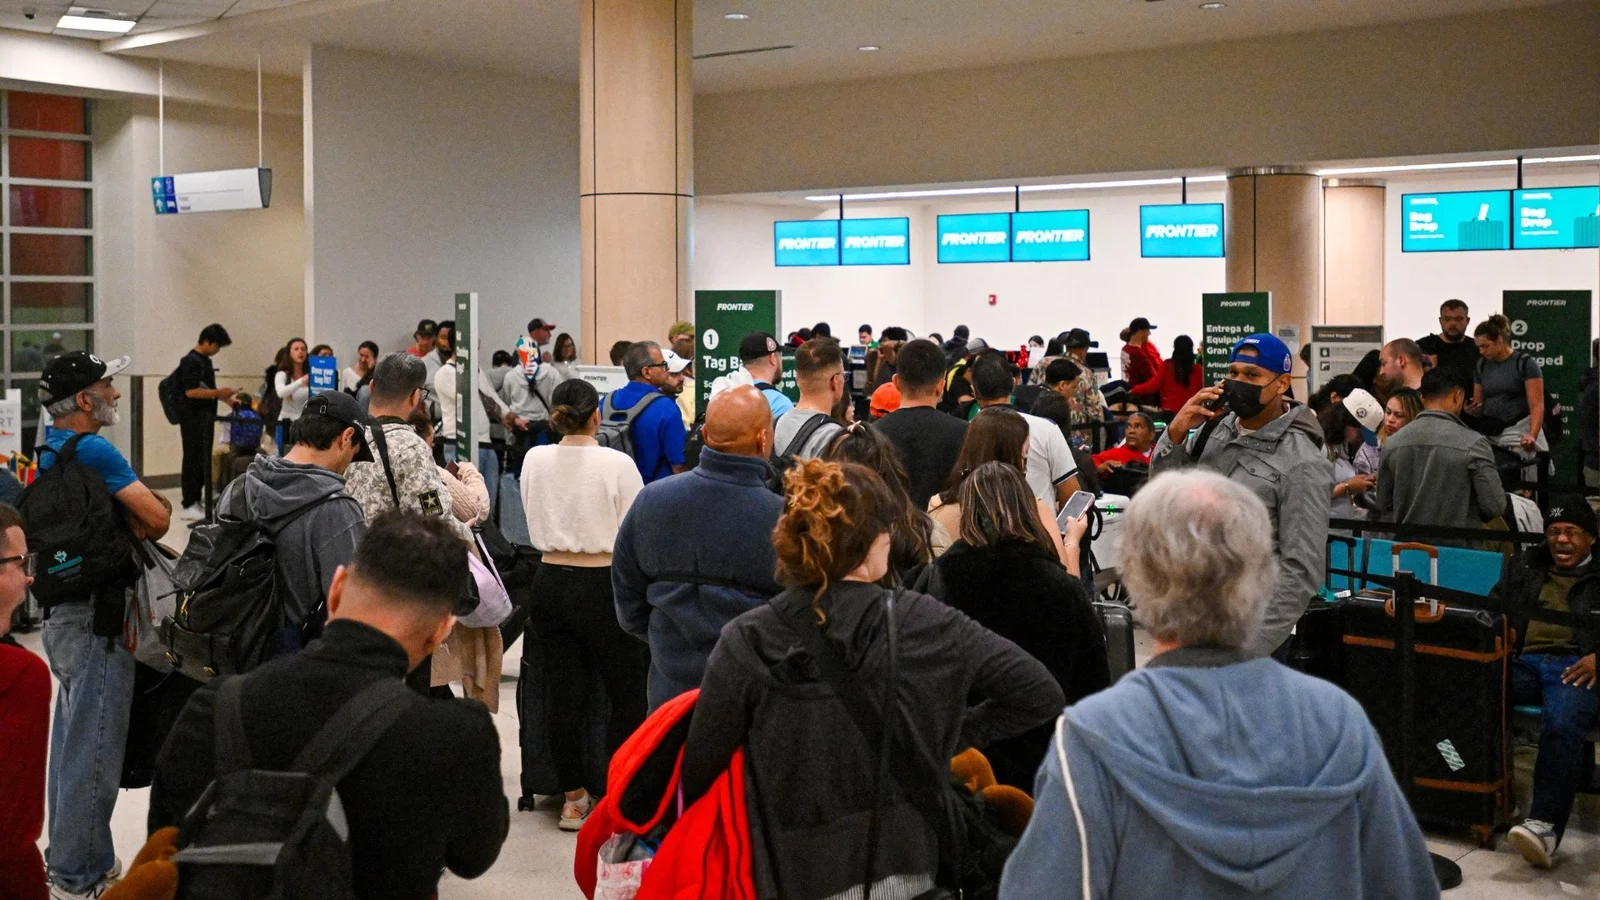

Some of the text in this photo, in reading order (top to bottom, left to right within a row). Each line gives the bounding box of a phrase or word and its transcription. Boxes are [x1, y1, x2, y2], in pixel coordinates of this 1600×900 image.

[1409, 211, 1433, 222] Bag
[1521, 207, 1546, 218] Bag
[1409, 221, 1438, 232] Drop
[1521, 217, 1552, 228] Drop
[1016, 229, 1084, 243] FRONTIER
[1145, 224, 1219, 238] FRONTIER
[778, 237, 836, 250] FRONTIER
[844, 235, 905, 248] FRONTIER
[941, 231, 1007, 245] FRONTIER
[717, 303, 754, 311] FRONTIER
[1206, 324, 1255, 333] Entrega de
[1206, 336, 1243, 344] Equipaj
[1511, 340, 1545, 352] Drop
[703, 355, 727, 371] Tag
